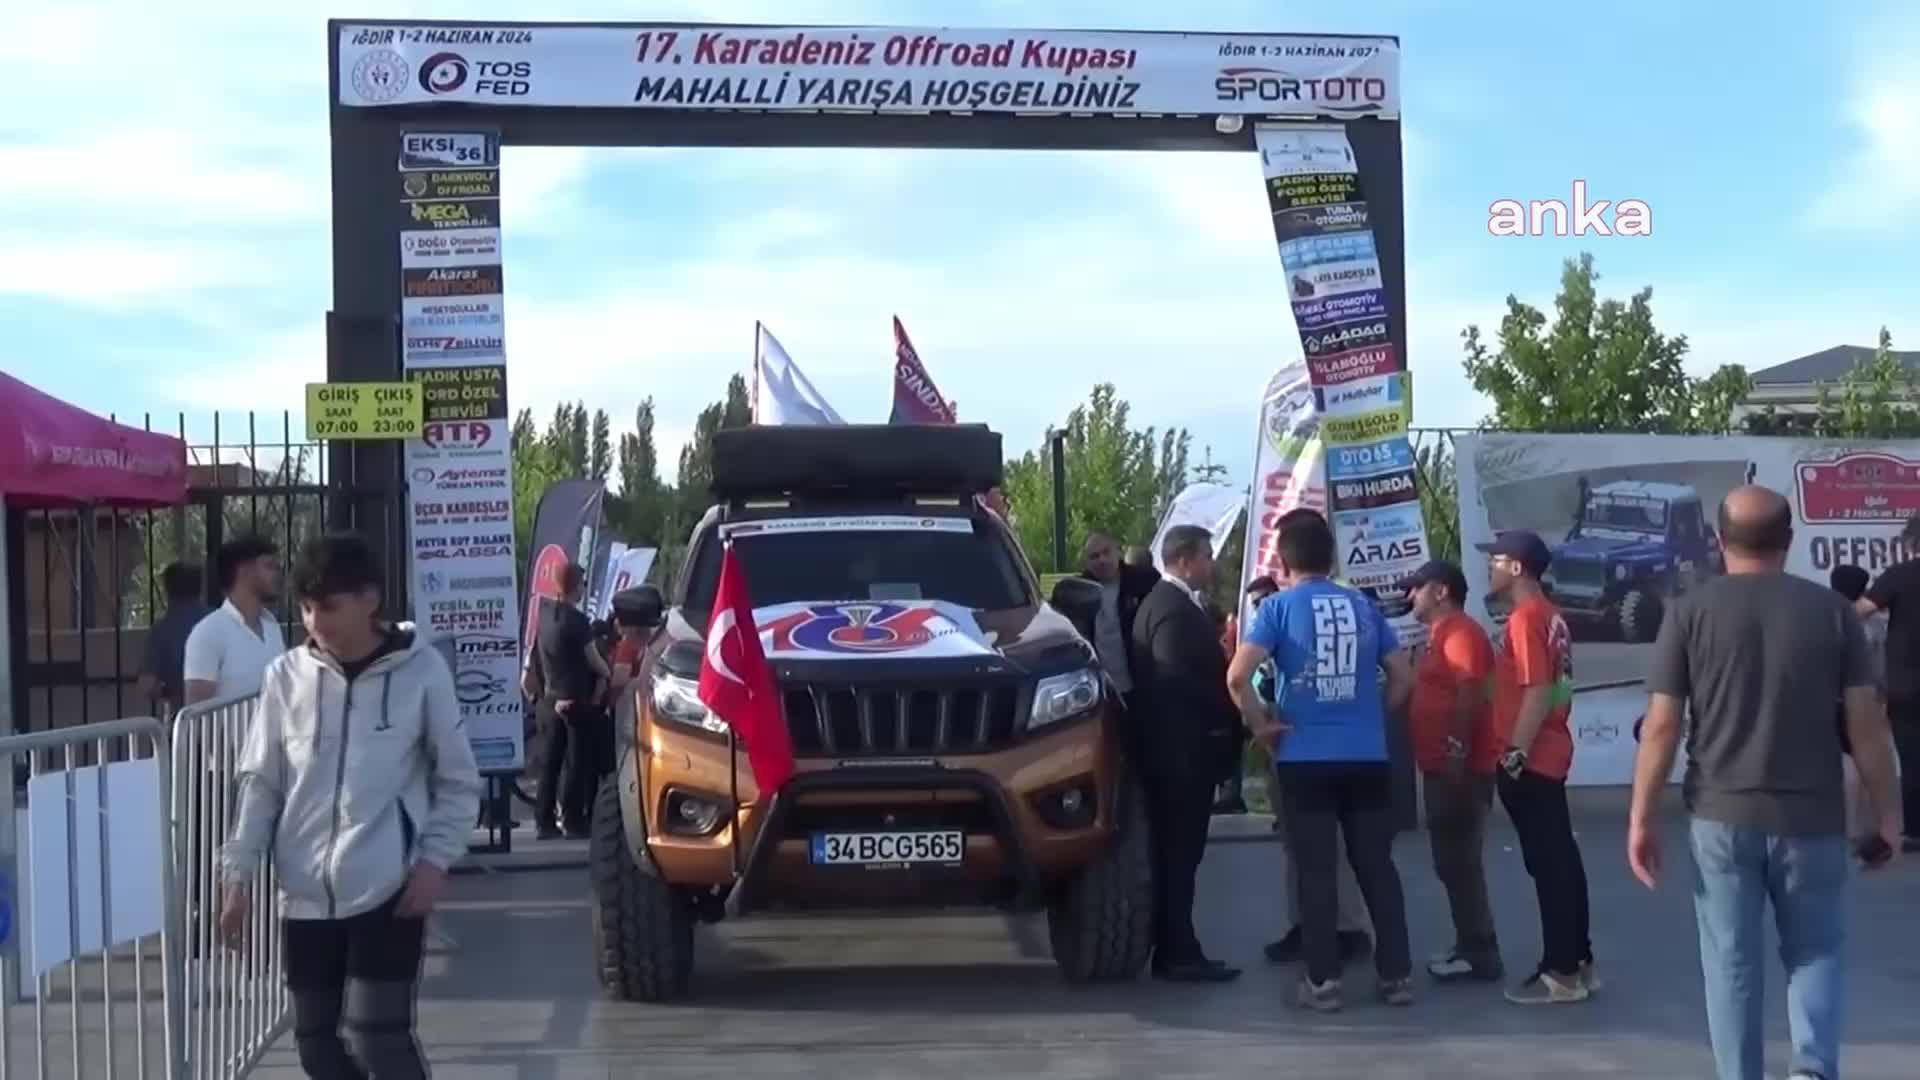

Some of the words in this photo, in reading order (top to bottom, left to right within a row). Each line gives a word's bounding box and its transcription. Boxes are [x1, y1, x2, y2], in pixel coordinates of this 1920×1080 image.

[496, 30, 533, 44] 2024
[636, 31, 682, 64] 17.
[693, 32, 876, 66] Karadeniz
[883, 35, 1015, 67] Offroad
[1021, 38, 1137, 76] Kupası
[476, 61, 531, 78] TOS
[475, 80, 530, 96] FED
[634, 71, 792, 104] MAHALLİ
[796, 77, 913, 109] YARIŞA
[921, 75, 1141, 109] HOŞGELDİNİZ
[456, 147, 481, 161] 36
[463, 368, 502, 381] USTA
[318, 387, 360, 404] GİRİŞ
[374, 388, 414, 405] ÇIKIŞ
[424, 388, 458, 401] ORD
[462, 385, 499, 400] ÖZEL
[325, 407, 353, 417] SAAT
[376, 407, 405, 417] SAAT
[316, 420, 358, 433] 07:00
[373, 419, 415, 433] 23:00
[422, 421, 491, 449] ATA
[1347, 537, 1422, 565] ARAS
[1312, 597, 1357, 636] 23
[826, 833, 960, 861] 34BCG565
